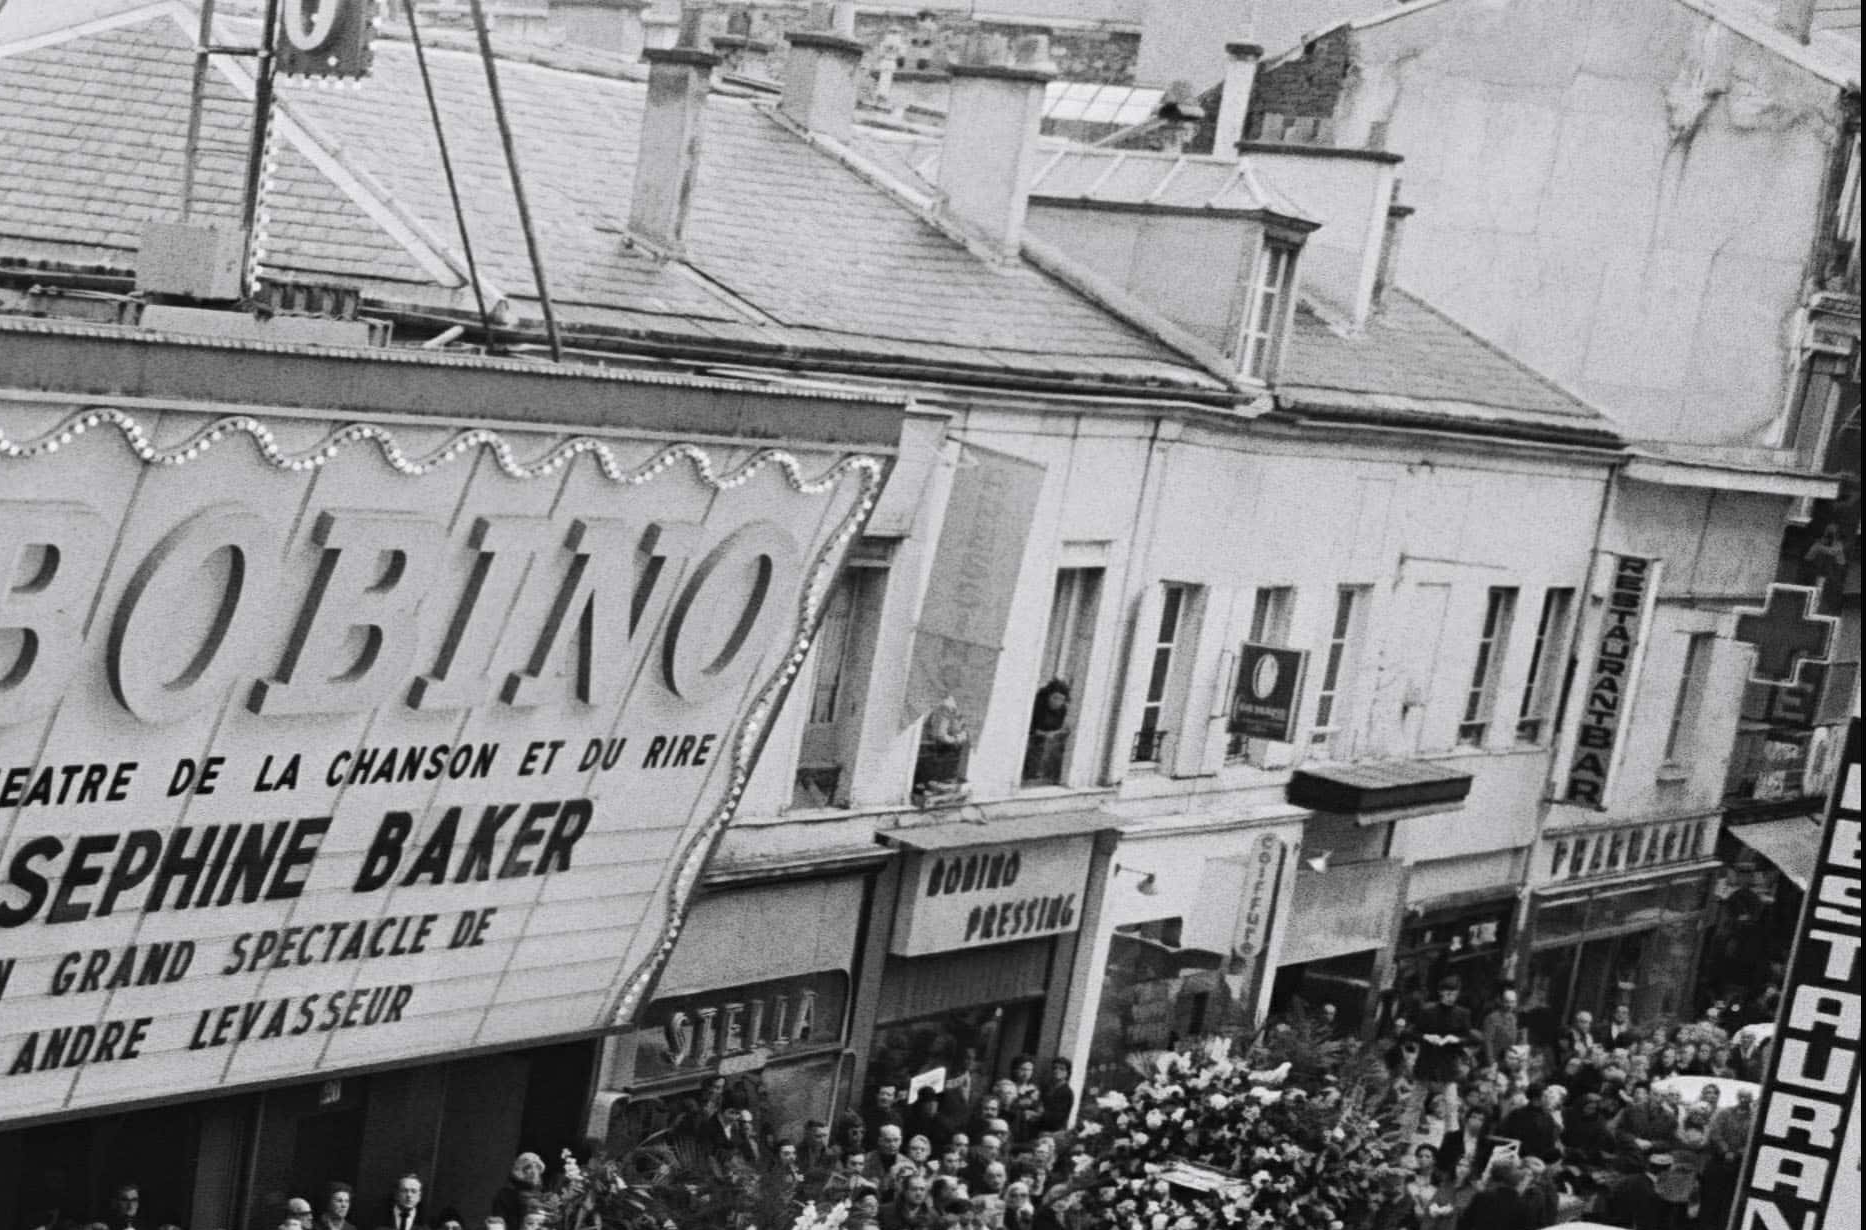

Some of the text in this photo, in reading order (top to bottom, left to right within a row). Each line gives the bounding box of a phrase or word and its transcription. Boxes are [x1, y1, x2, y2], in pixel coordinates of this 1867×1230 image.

[1567, 557, 1648, 806] RESTAURANT BAR
[167, 756, 225, 797] DE
[254, 754, 301, 792] LA
[326, 743, 499, 787] CHANSON
[518, 741, 564, 776] ET
[578, 738, 626, 772] DU
[643, 734, 716, 768] RIRE
[352, 798, 594, 894] BAKER
[926, 850, 1021, 898] BOBINO
[49, 943, 196, 997] GRAND
[223, 914, 438, 976] SPECTACLE
[448, 907, 496, 949] DE
[964, 893, 1076, 942] PRESSING
[7, 985, 413, 1076] ANDRE LEVASSEUR
